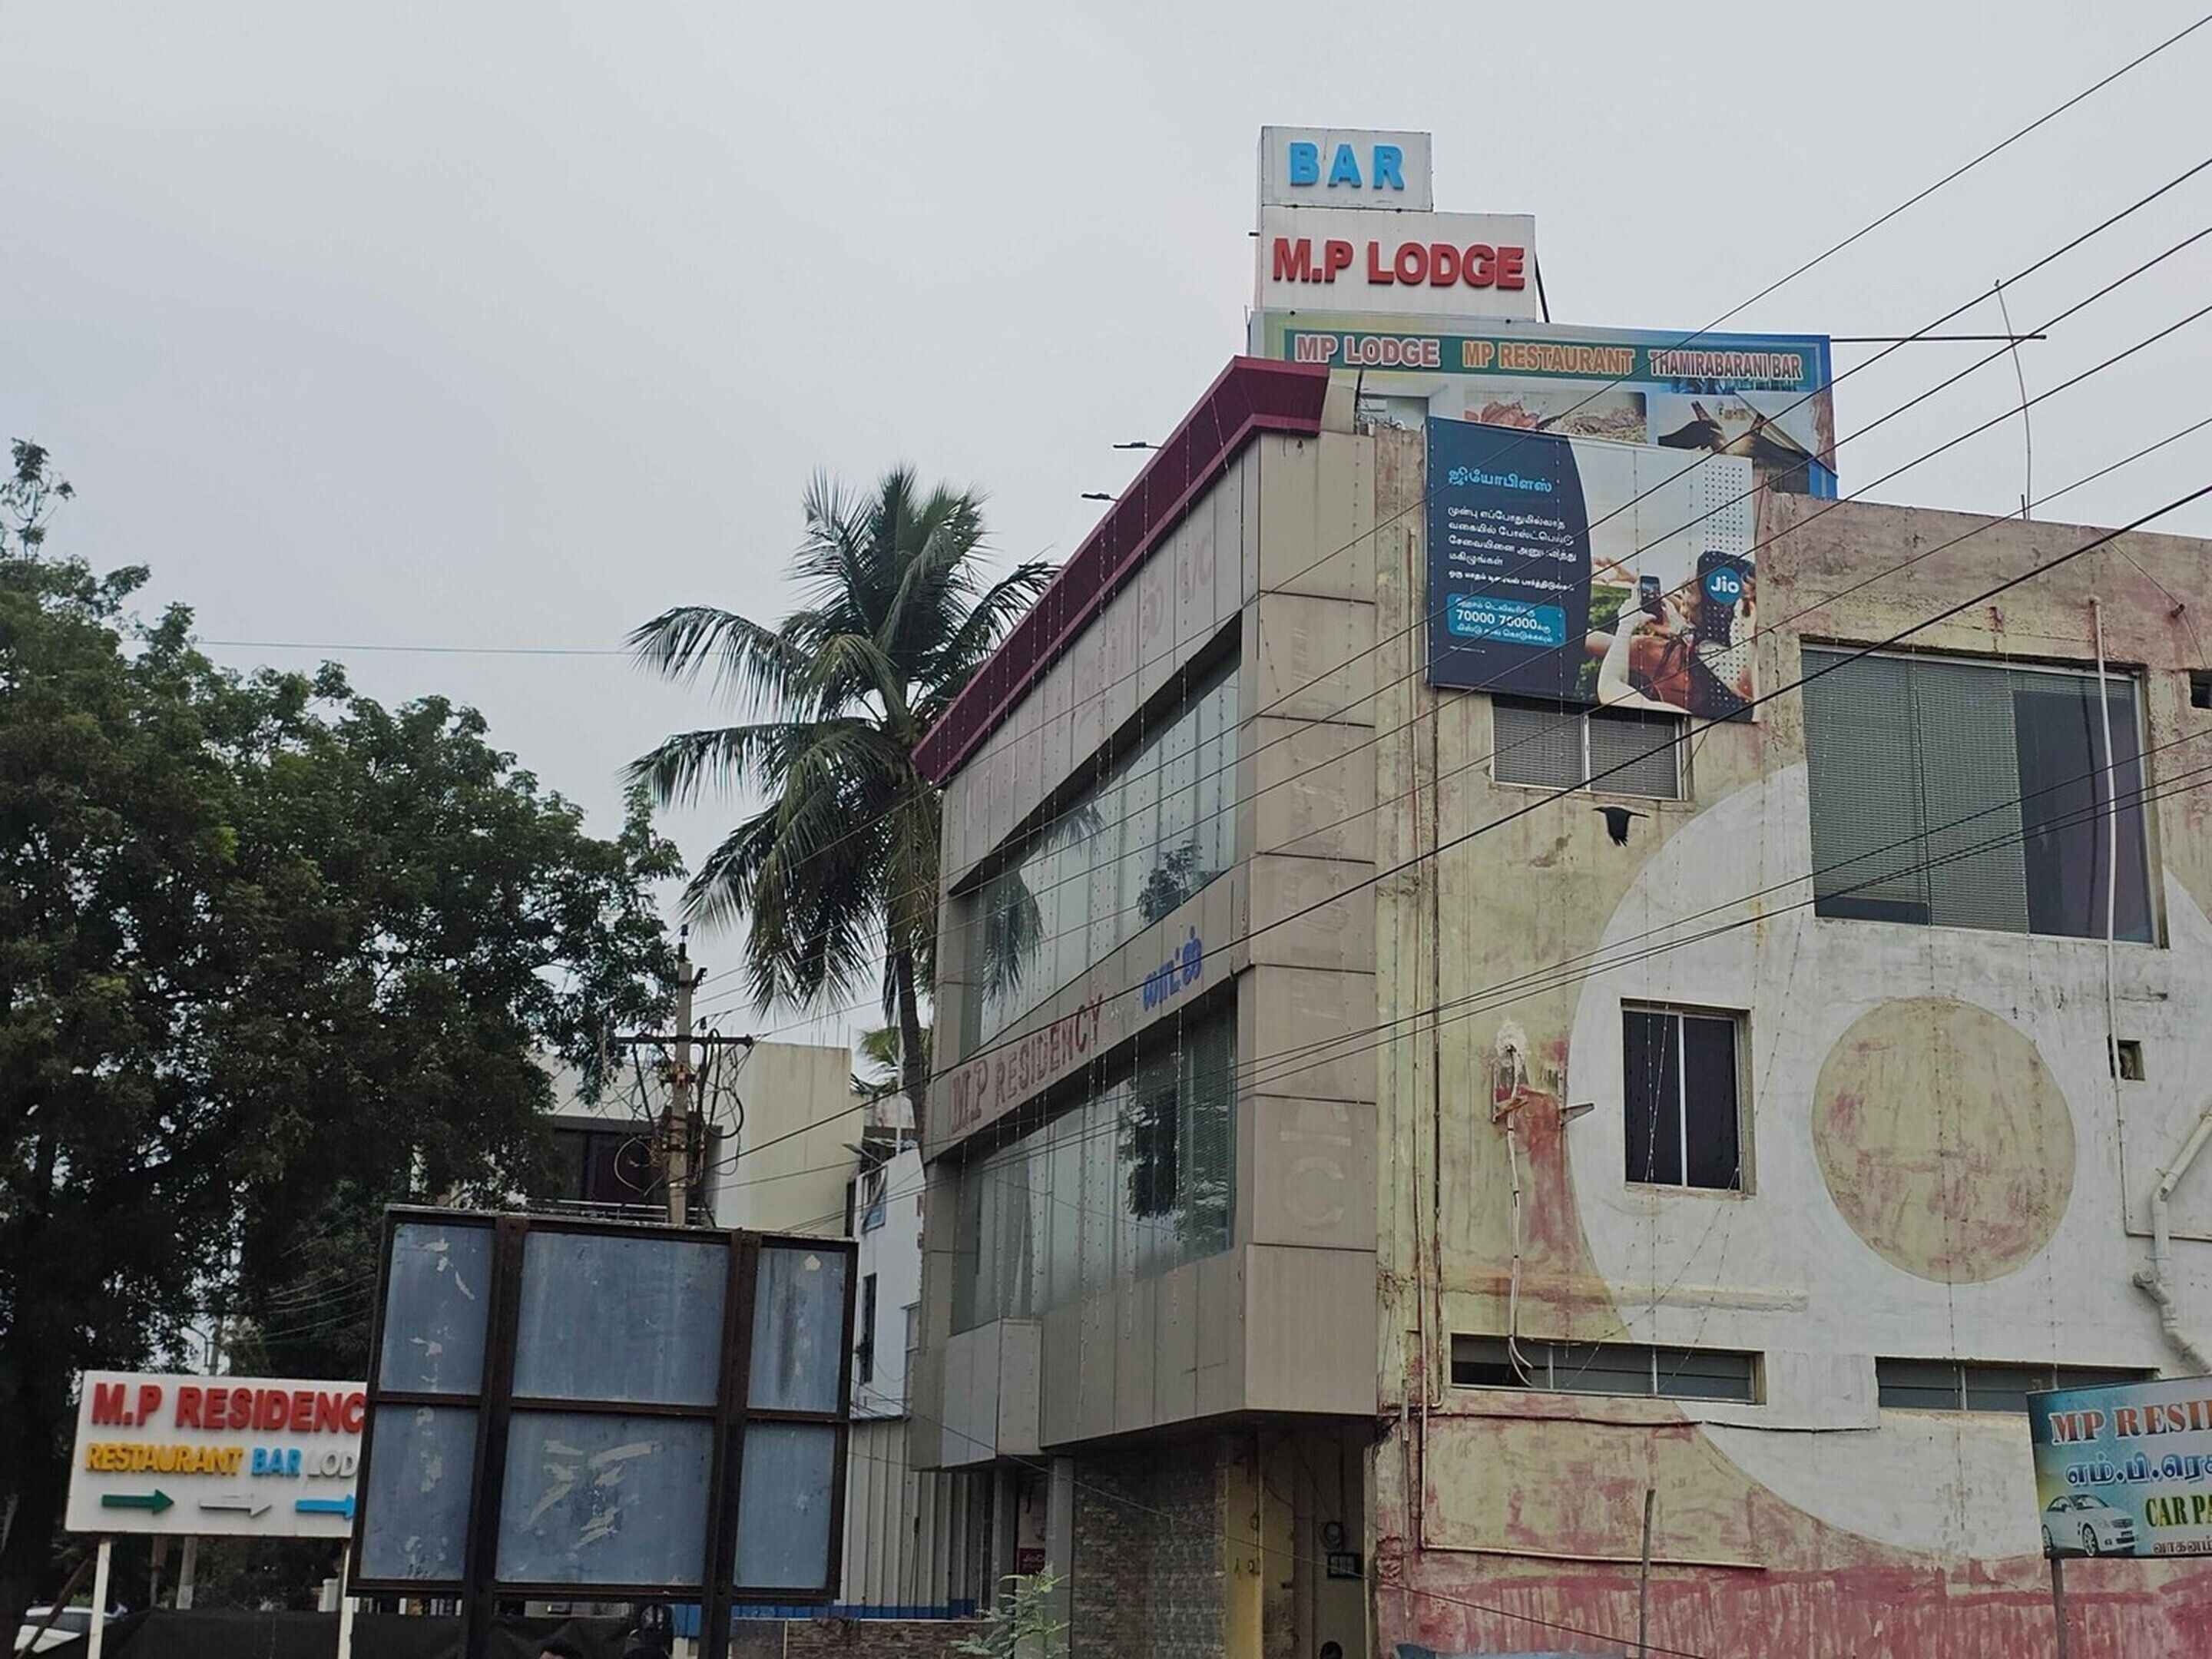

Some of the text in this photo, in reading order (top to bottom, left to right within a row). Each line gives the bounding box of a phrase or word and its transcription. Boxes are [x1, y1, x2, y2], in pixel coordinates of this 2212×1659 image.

[1290, 142, 1405, 190] BAR
[1273, 237, 1525, 290] M.P LODGE
[1295, 333, 1803, 381] MP LODGE MP RESTAURANT THAMIRABARANI BAR
[1710, 575, 1740, 595] Jio
[1455, 609, 1495, 624] 70000
[995, 993, 1104, 1107] RESIDENCY
[91, 1382, 162, 1426] M.P
[2048, 1409, 2106, 1445] MP
[84, 1442, 246, 1478] RESTAURANT
[250, 1447, 303, 1479] BAR
[2145, 1496, 2188, 1528] CAR
